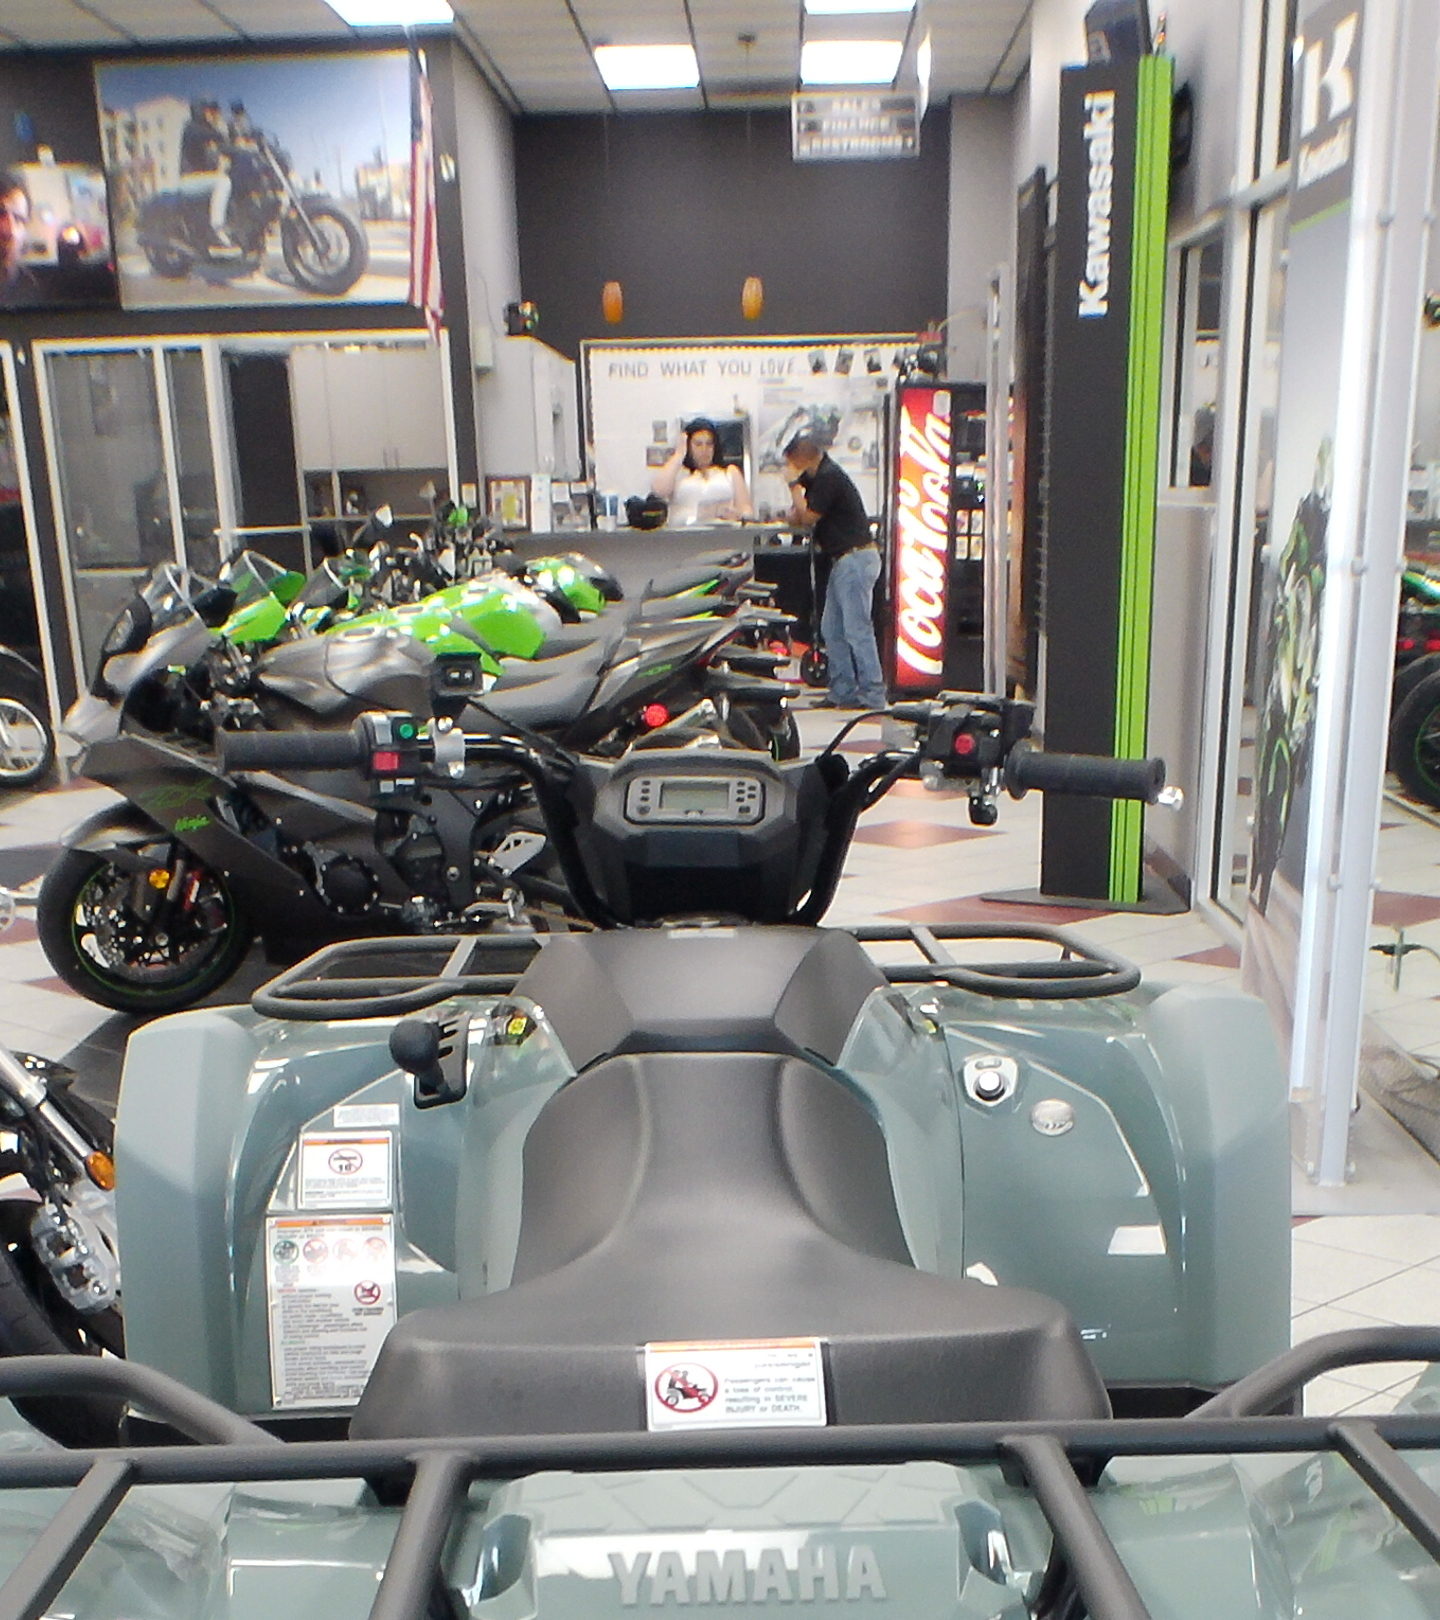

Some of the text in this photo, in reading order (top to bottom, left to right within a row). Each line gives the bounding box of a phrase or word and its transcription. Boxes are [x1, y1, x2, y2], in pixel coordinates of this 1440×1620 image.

[1079, 90, 1115, 318] Kawasaki
[608, 356, 795, 378] FIND WHAT YOU LOVE
[775, 1394, 808, 1402] SEVERE
[725, 1405, 756, 1414] INJURY
[607, 1543, 887, 1606] YAMAHA
